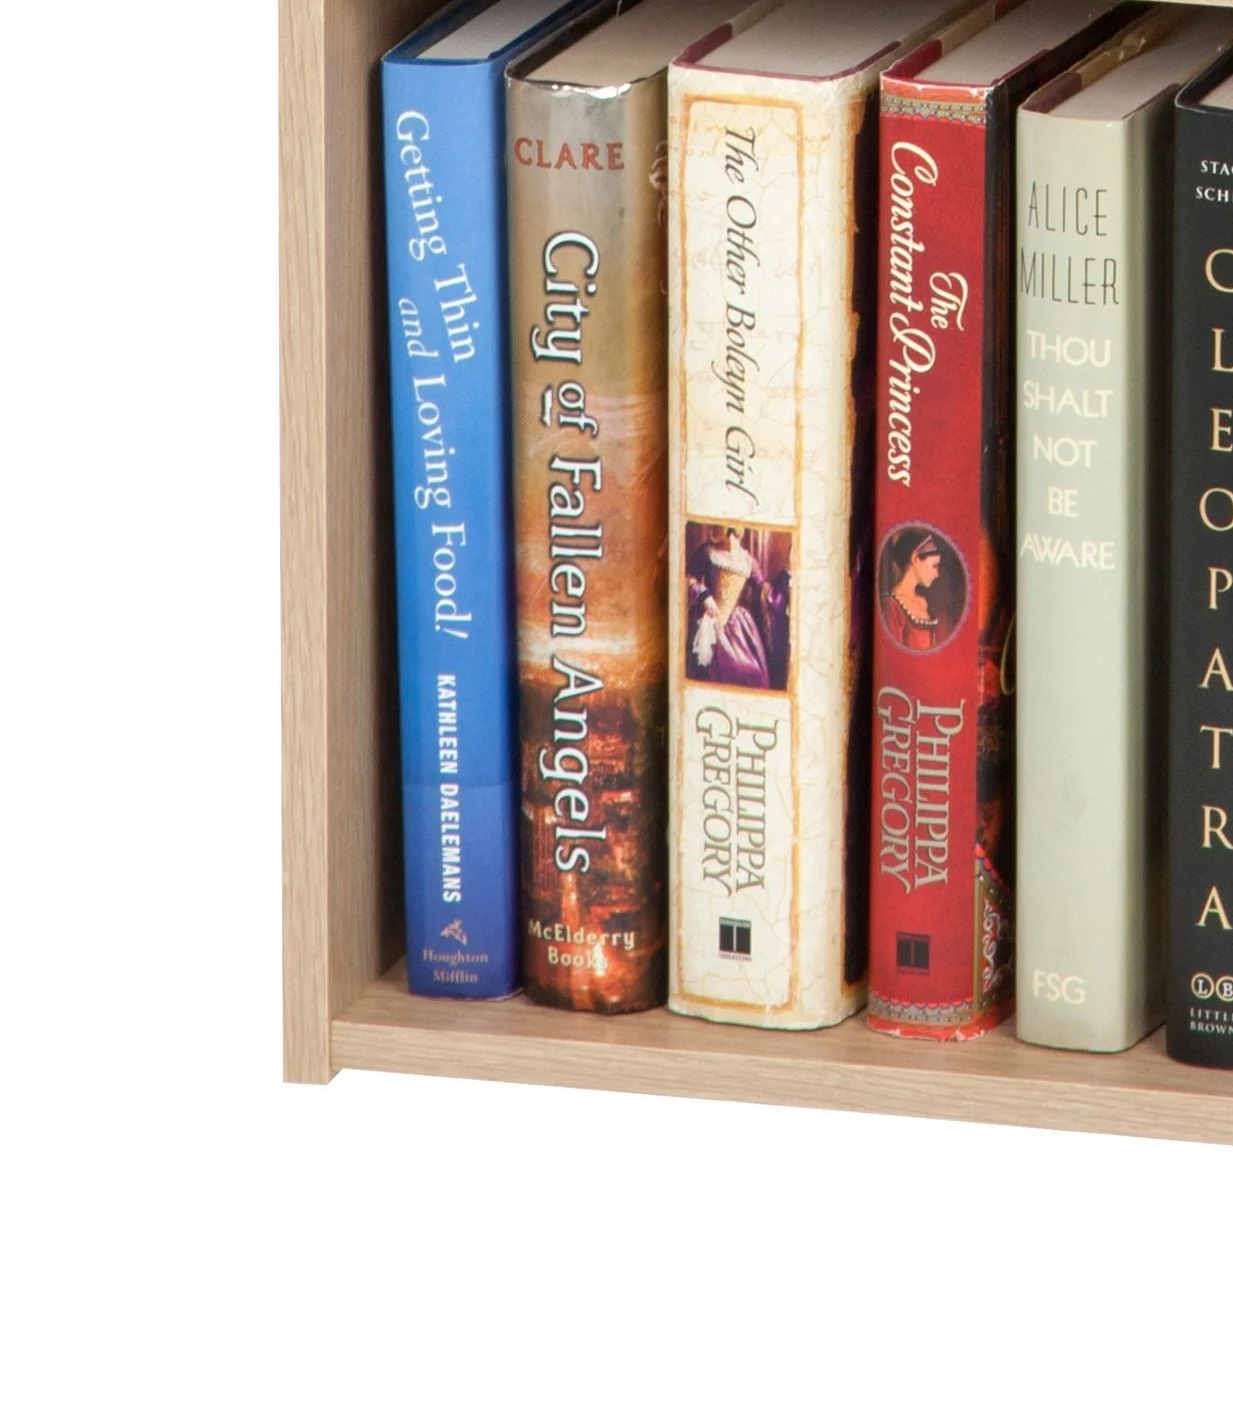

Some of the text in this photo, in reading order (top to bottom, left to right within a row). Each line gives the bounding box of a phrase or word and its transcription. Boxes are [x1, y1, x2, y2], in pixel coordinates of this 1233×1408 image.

[514, 136, 625, 172] CLARE
[396, 110, 480, 364] Getting Thin
[1027, 181, 1109, 237] ALICE
[929, 271, 969, 332] The
[1019, 246, 1120, 306] MILLER
[711, 127, 760, 508] The Other Boleyn Girl
[888, 140, 939, 487] Constant Princess
[1026, 329, 1111, 369] THOU
[1023, 380, 1114, 419] SHALT
[398, 297, 473, 640] and Loving Food!
[1033, 433, 1098, 470] NOT
[1048, 486, 1080, 518] BE
[531, 231, 607, 875] City of Fallen Angels
[1019, 532, 1117, 571] AWARE
[437, 674, 461, 903] KATHLEEN DAELEMANS
[696, 706, 734, 897] GREGORY
[735, 718, 780, 893] PHILIPPA
[876, 685, 918, 893] GREGORY
[914, 698, 965, 887] PHILIPPA
[422, 948, 489, 966] Houghton
[527, 918, 636, 951] McElderry
[547, 948, 610, 972] Books
[433, 969, 479, 984] Mifflin
[1033, 969, 1086, 1006] FSG
